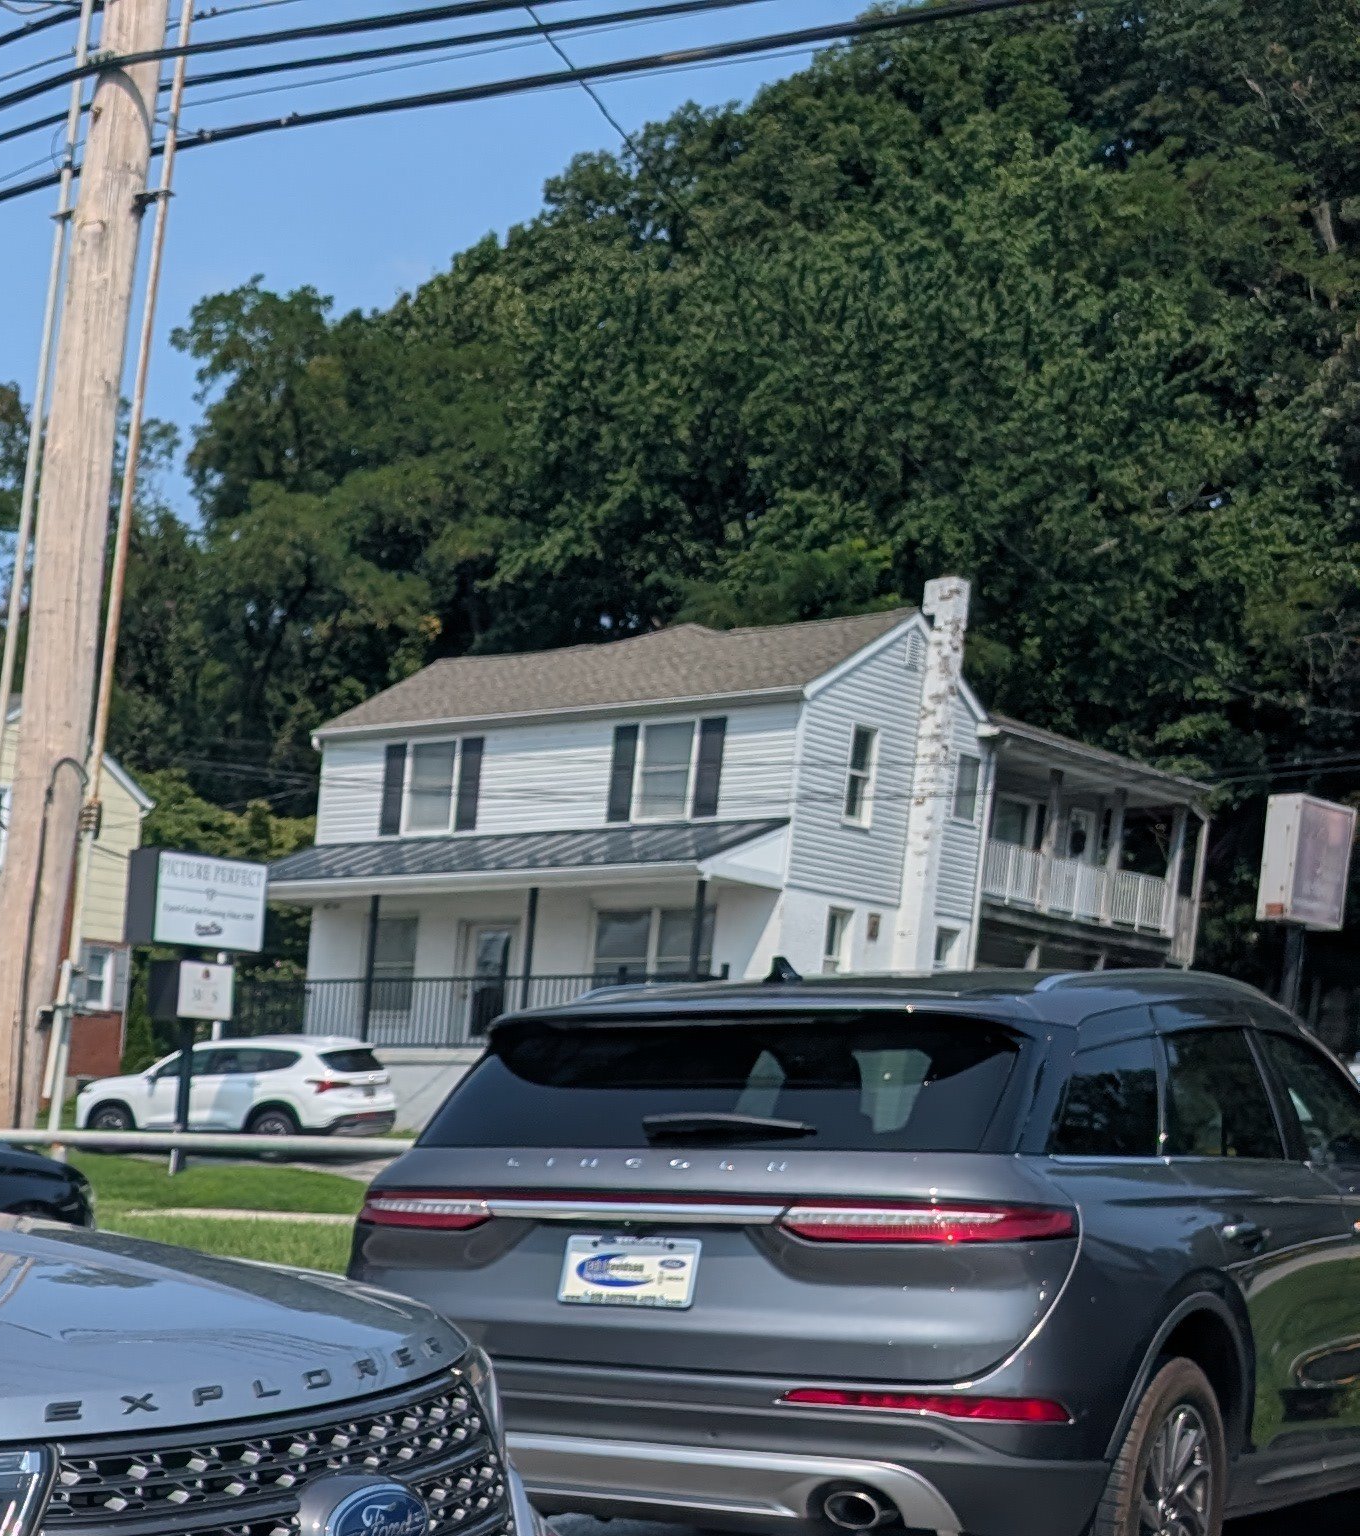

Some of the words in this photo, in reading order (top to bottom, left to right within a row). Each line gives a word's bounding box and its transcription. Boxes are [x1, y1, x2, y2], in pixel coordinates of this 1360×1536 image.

[160, 858, 210, 881] PICTURE
[214, 865, 263, 887] PERFECT
[43, 1336, 444, 1423] EXPLORER
